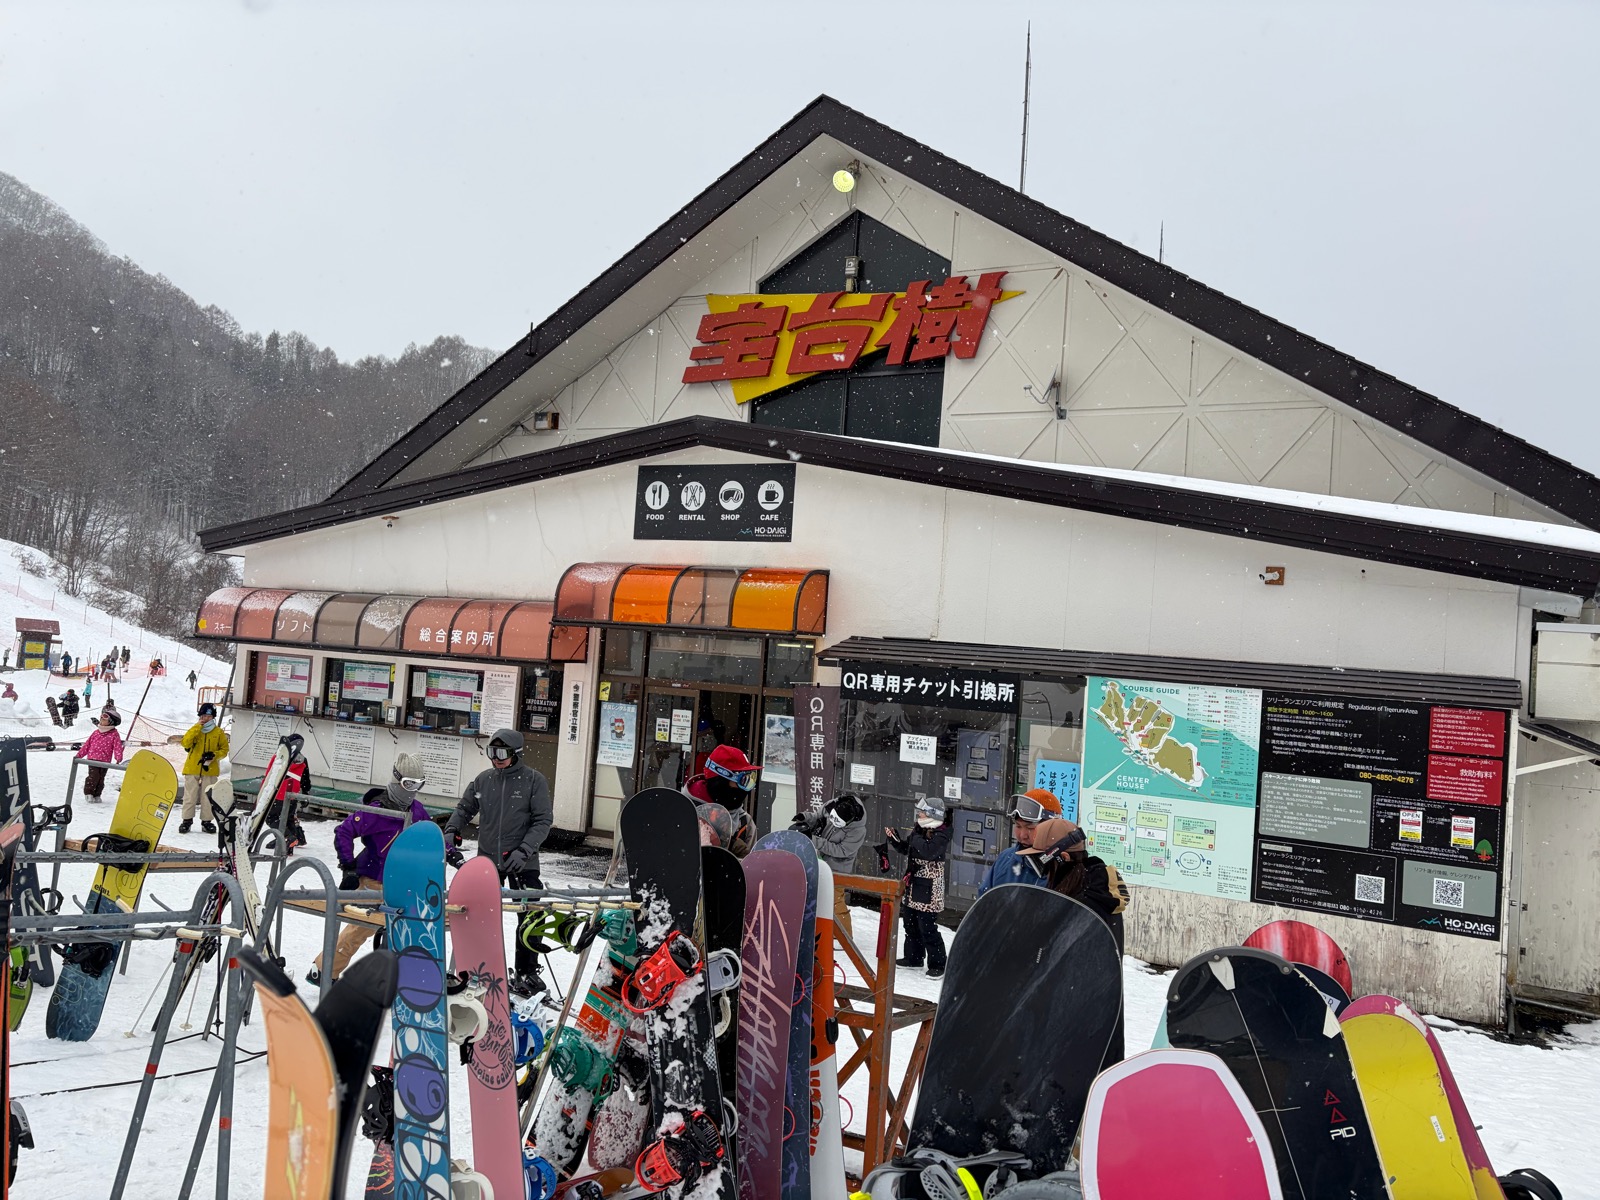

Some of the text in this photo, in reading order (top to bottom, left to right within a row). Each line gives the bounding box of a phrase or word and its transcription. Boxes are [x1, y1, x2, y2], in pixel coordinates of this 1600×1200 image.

[682, 271, 1009, 384] 宝台樹
[214, 622, 232, 631] スキー
[277, 620, 311, 633] リフト
[419, 627, 496, 647] 総合案内所
[842, 671, 1015, 703] QR専用チケット引換所
[1123, 684, 1180, 695] COURSE GUIDE
[525, 698, 558, 707] INFORMATION
[1266, 695, 1345, 709] ツリーランエリアご利用規定
[1347, 702, 1376, 713] Regulation
[991, 738, 998, 747] 7
[1459, 768, 1493, 779] 救助有料
[1116, 774, 1150, 785] CENTER
[1116, 781, 1145, 790] HOUSE
[1401, 811, 1420, 819] OPEN
[987, 818, 993, 827] 8
[1452, 817, 1473, 825] CLOSED
